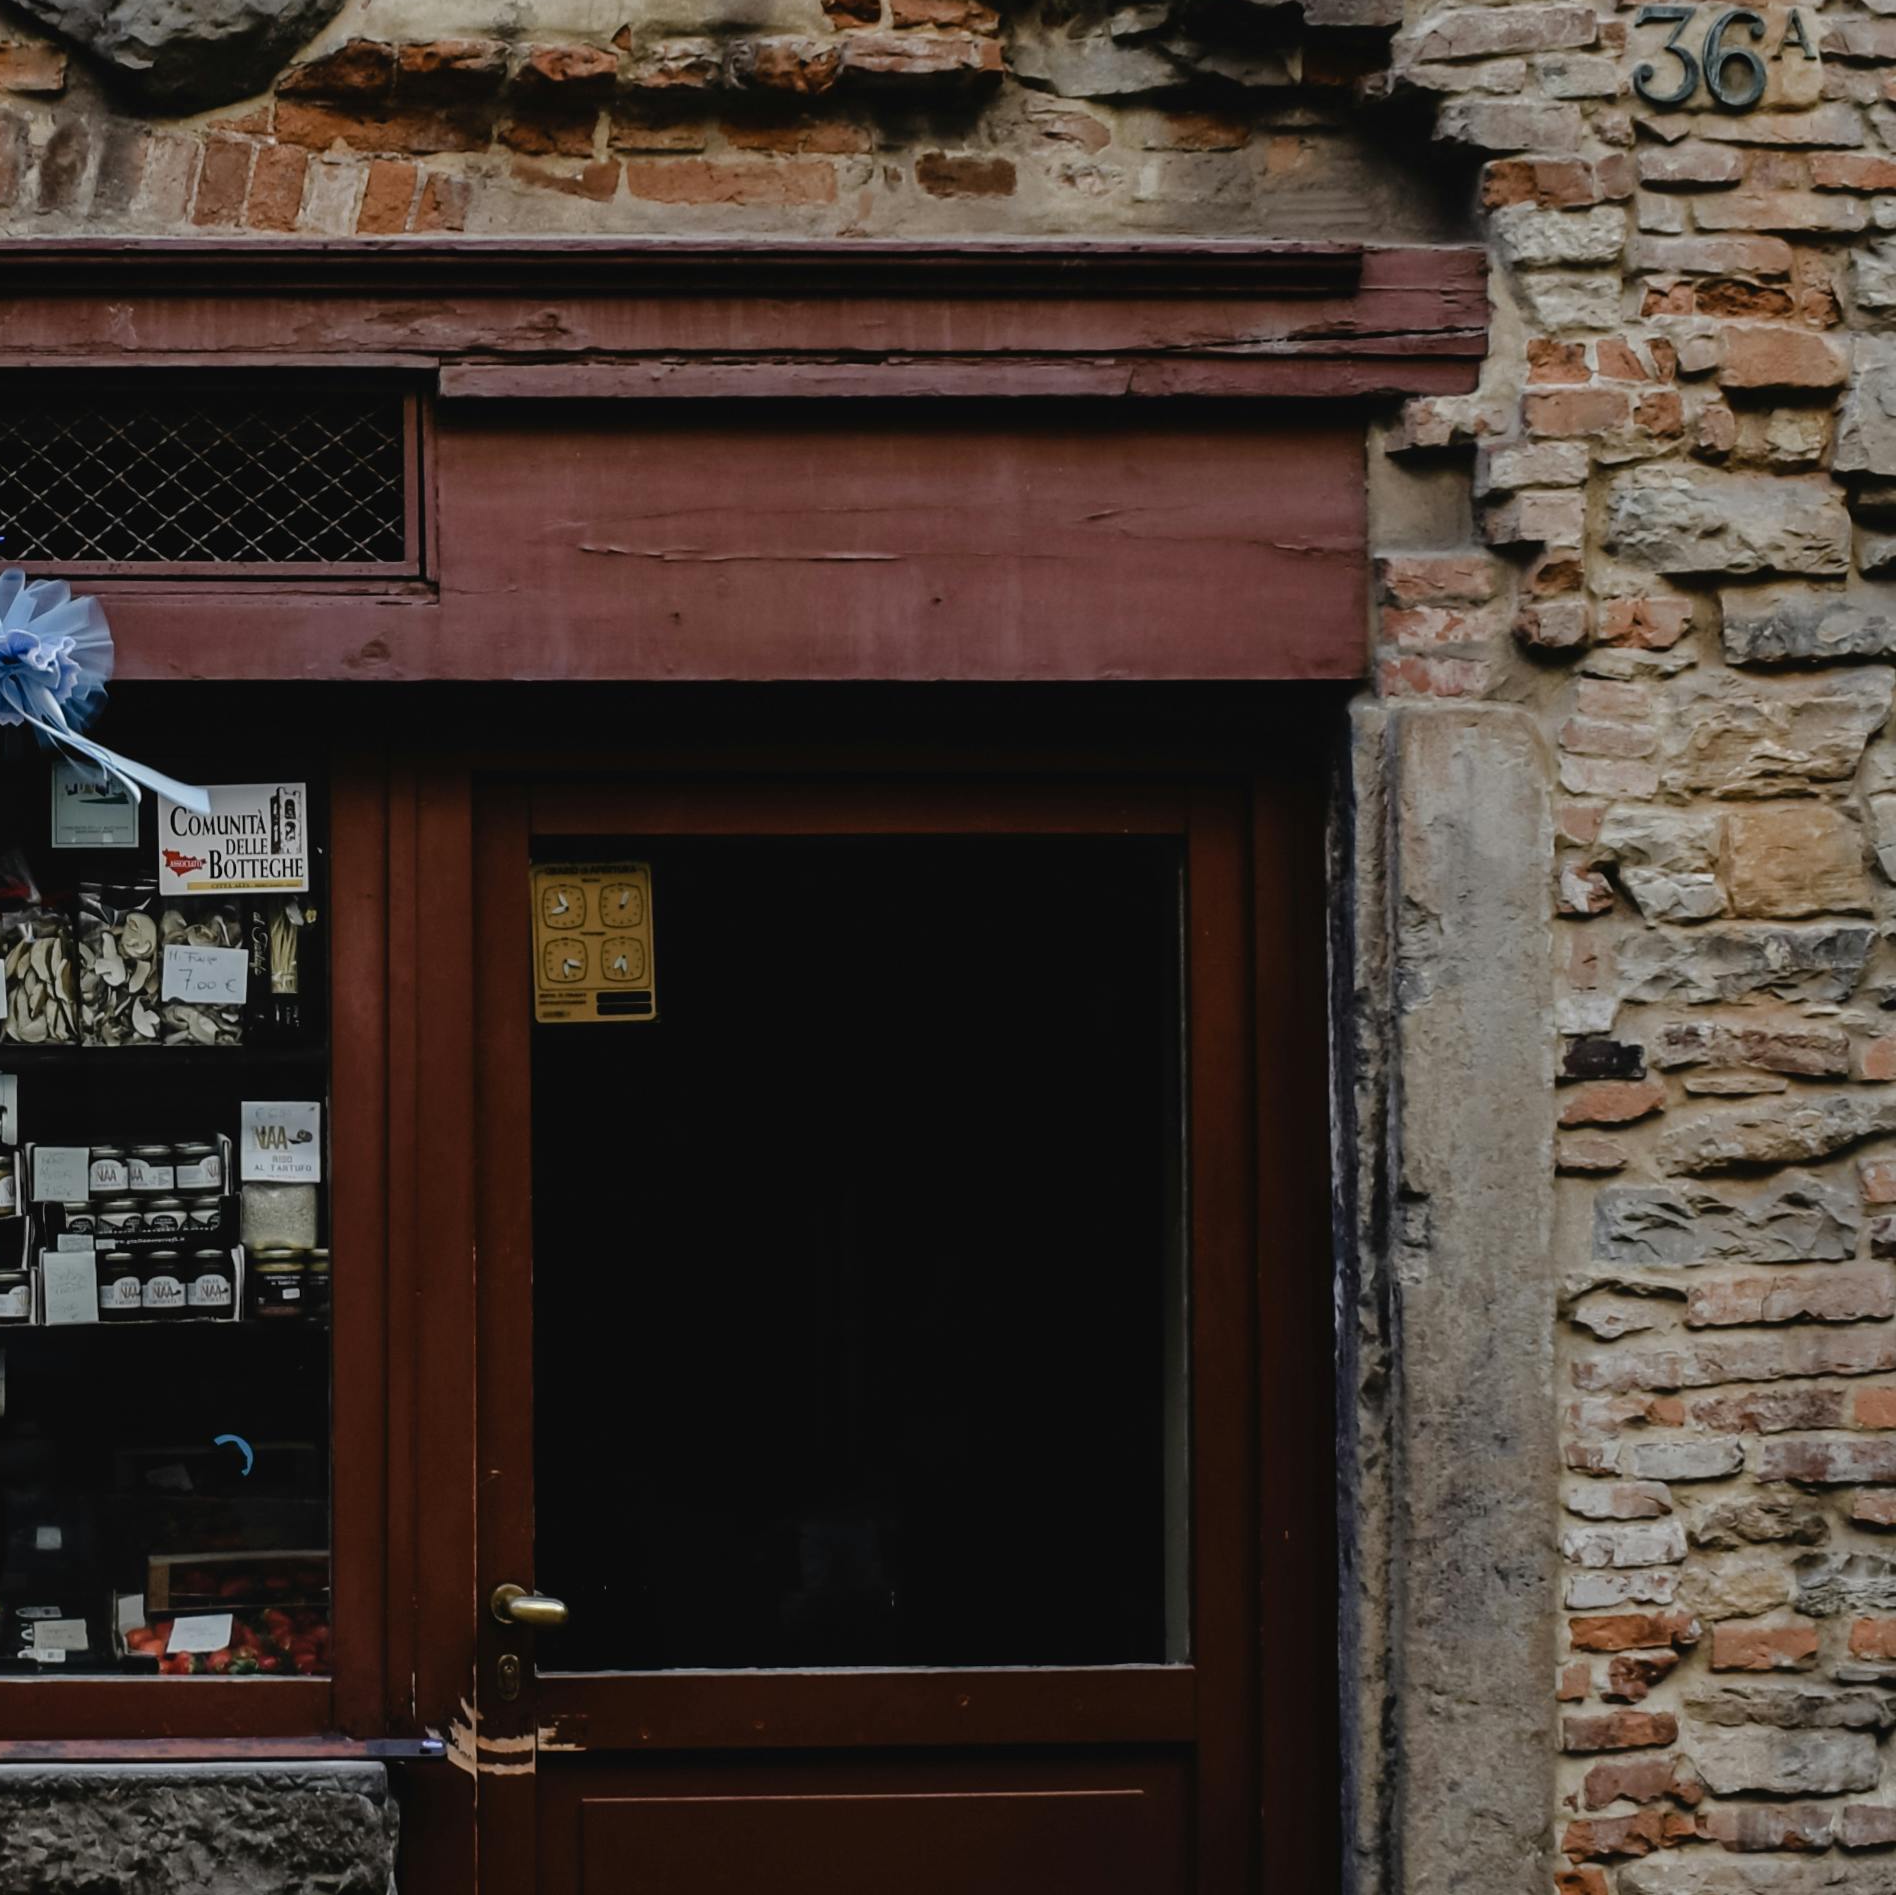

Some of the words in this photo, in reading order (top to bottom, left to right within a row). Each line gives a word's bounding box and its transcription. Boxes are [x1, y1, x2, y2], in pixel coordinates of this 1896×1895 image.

[170, 806, 266, 837] COMUNITÀ
[226, 838, 268, 855] DELLE
[209, 850, 304, 879] BOTTEGHE
[270, 1164, 312, 1172] TARTUFO
